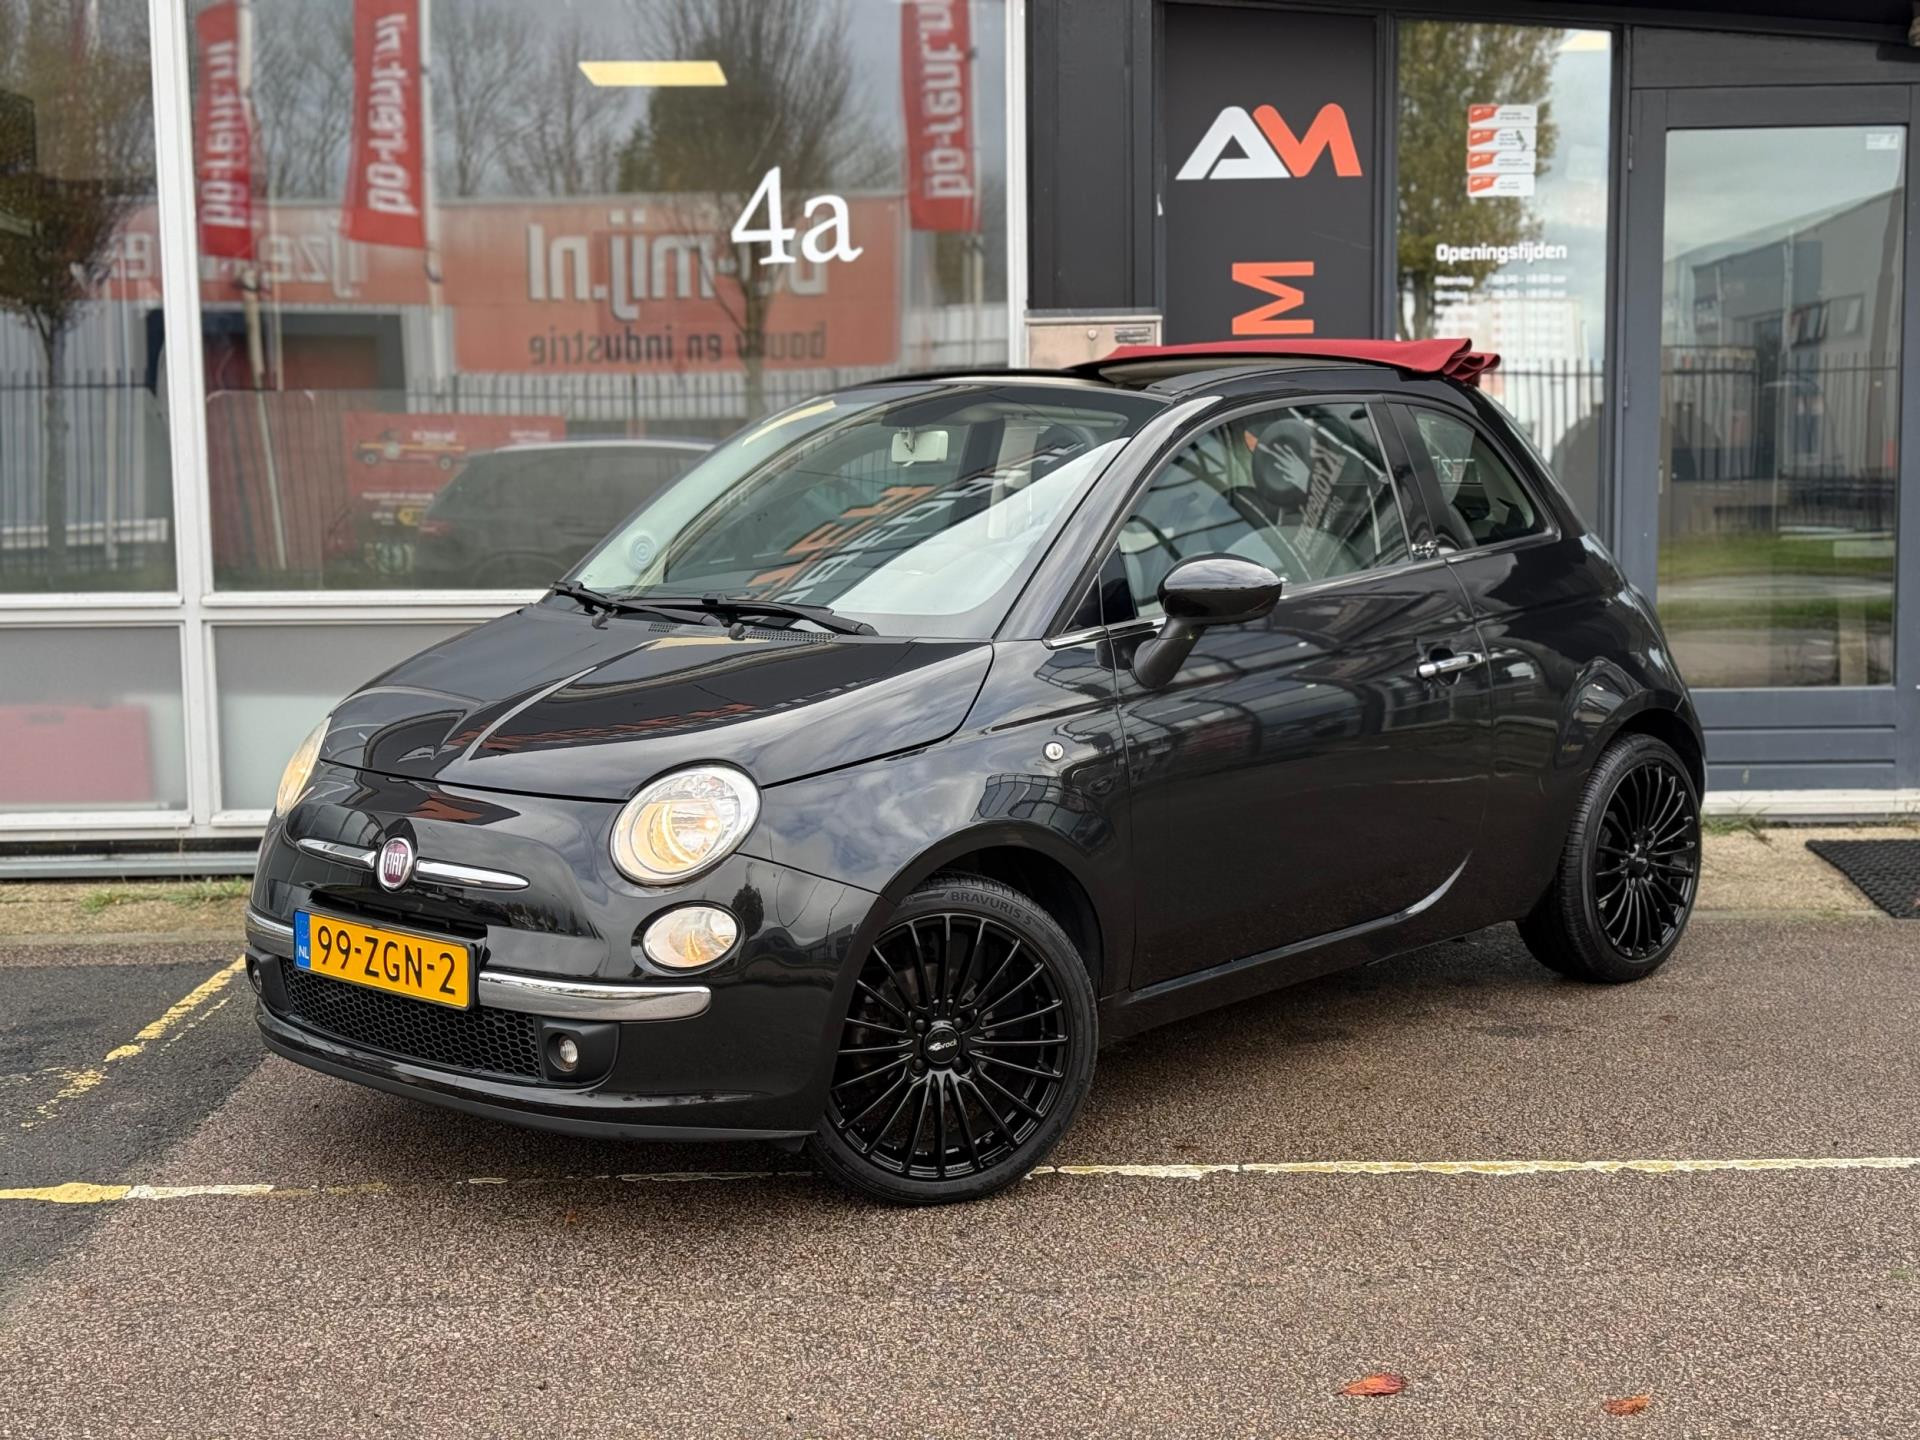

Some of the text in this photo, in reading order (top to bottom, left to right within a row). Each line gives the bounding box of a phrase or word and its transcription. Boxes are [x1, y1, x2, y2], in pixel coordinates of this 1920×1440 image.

[1175, 102, 1362, 180] AM
[731, 165, 864, 266] 4a
[1435, 242, 1568, 266] Openingstijden
[384, 851, 406, 876] FIAT
[951, 891, 1022, 920] BRAVURIS
[298, 945, 310, 960] NL
[317, 925, 456, 995] 99-ZGN-2
